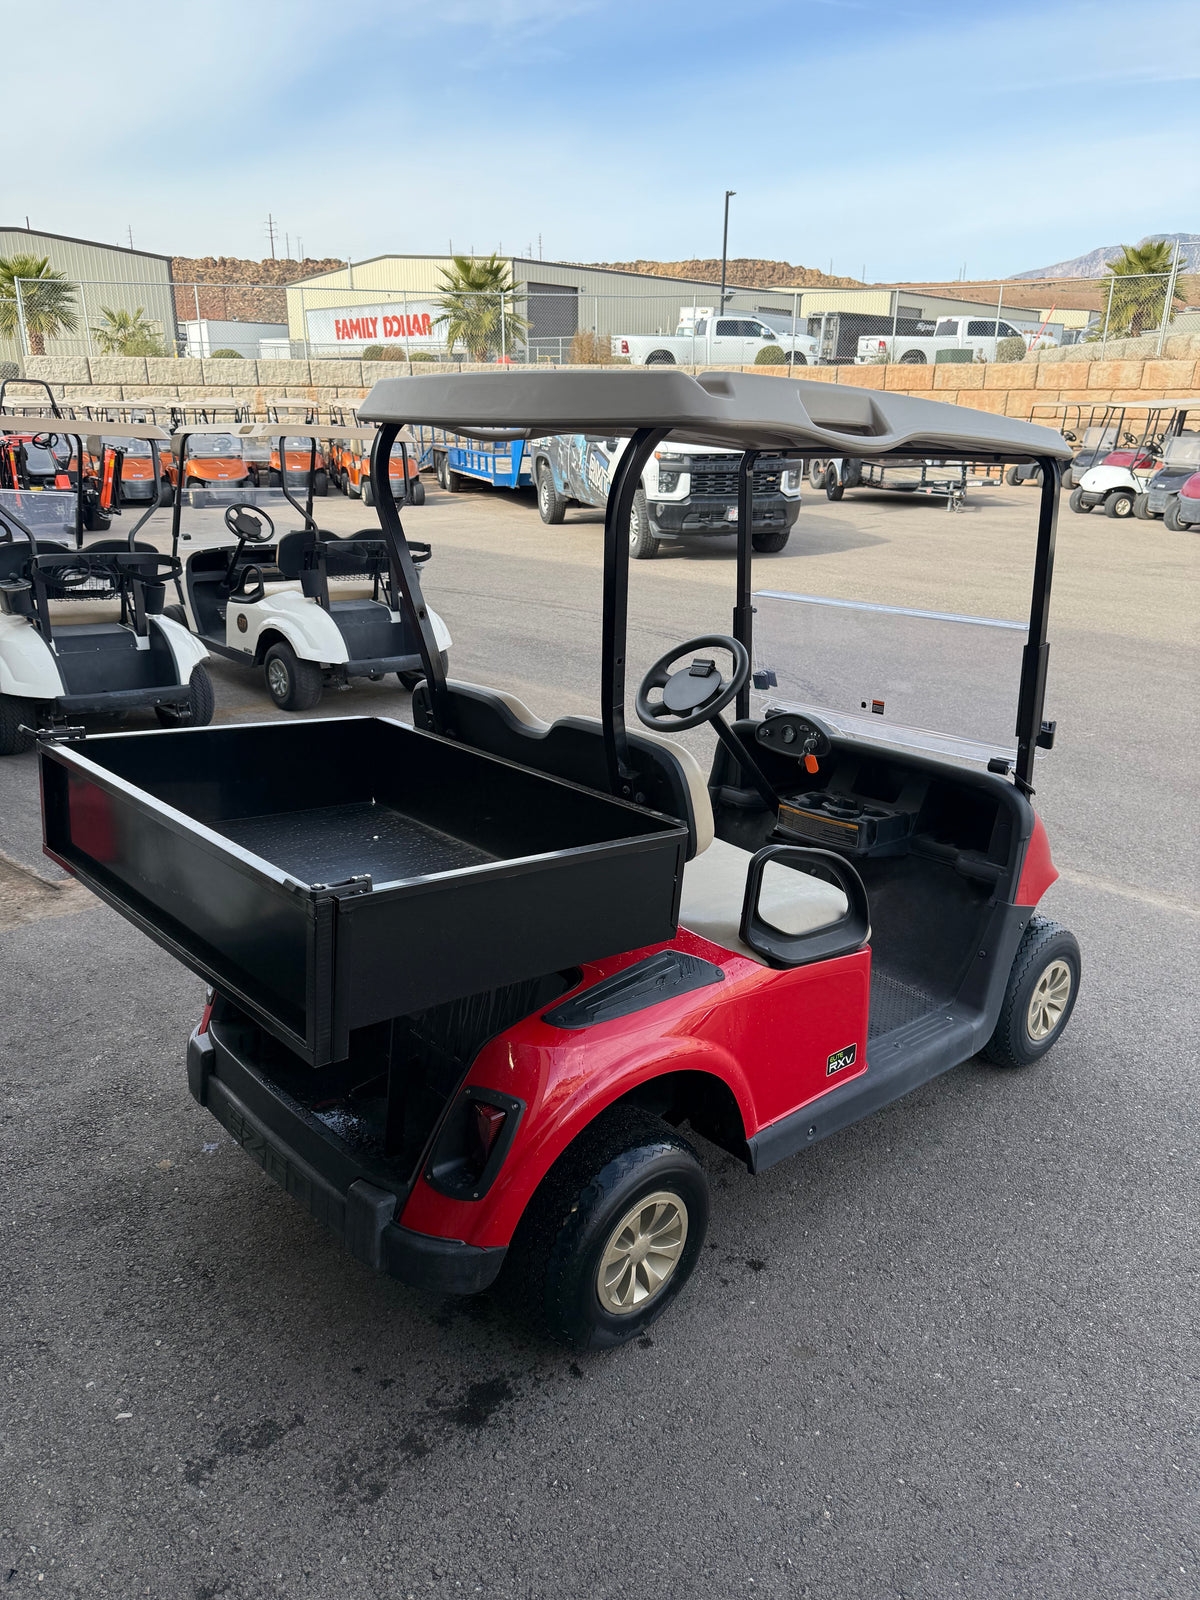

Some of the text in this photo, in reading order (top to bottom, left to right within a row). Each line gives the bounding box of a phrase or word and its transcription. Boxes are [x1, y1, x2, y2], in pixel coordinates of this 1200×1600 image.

[334, 313, 432, 340] FAMILY DOLLAR
[693, 462, 783, 472] CHEVLET
[828, 1053, 854, 1073] RXV
[830, 1052, 844, 1063] ELITE
